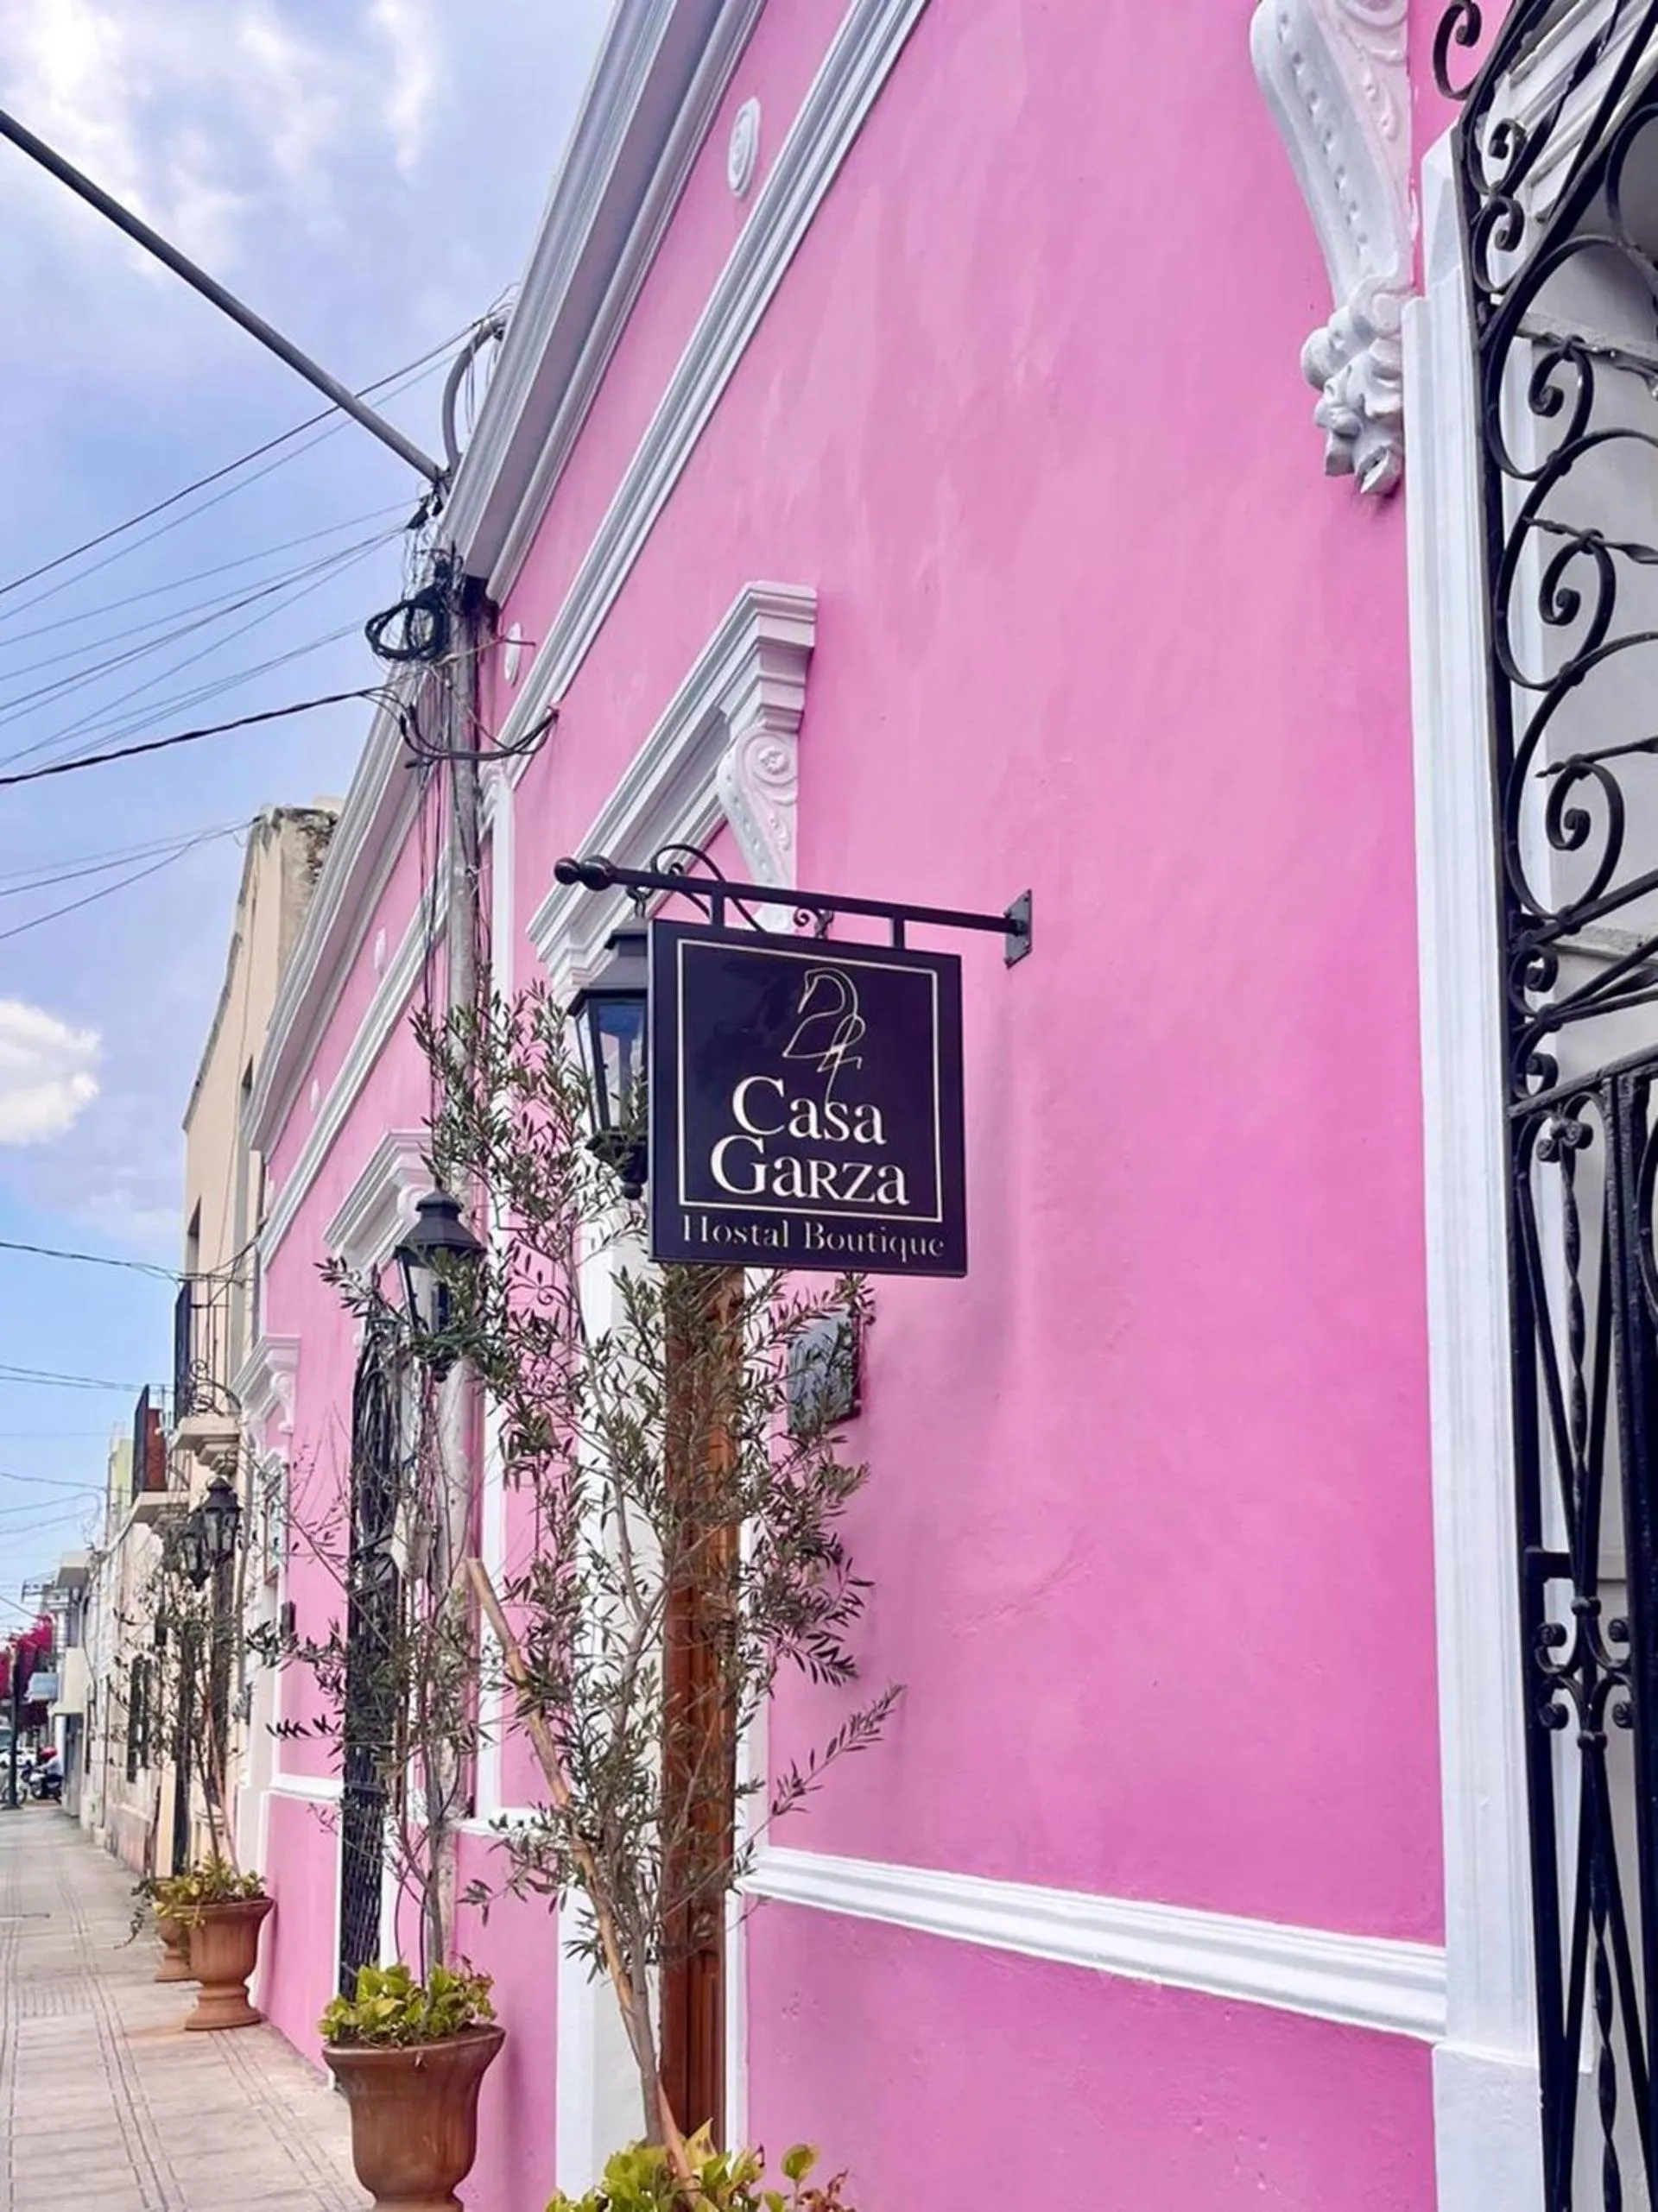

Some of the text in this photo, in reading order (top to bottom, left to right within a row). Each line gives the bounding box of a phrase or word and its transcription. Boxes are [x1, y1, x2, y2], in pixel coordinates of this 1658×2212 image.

[732, 1076, 887, 1146] Casa
[683, 1214, 944, 1263] Hostal Boutique
